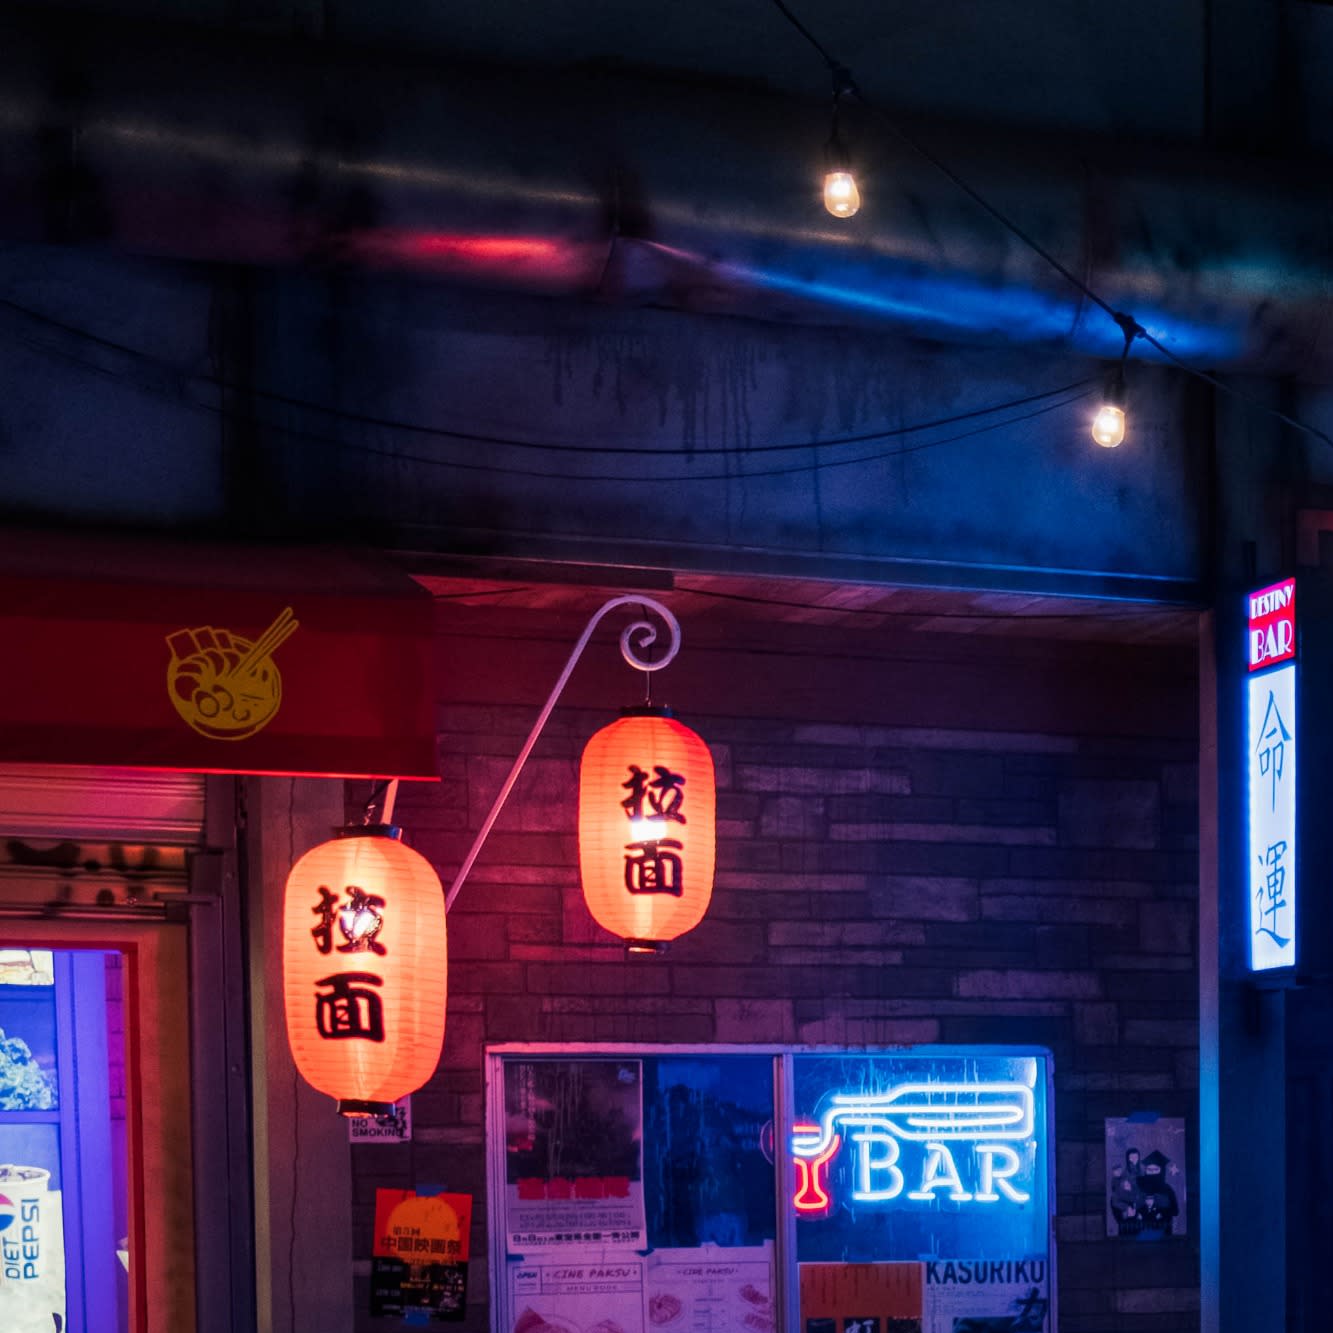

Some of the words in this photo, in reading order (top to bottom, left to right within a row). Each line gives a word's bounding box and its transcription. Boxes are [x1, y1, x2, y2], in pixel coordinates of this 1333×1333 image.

[1251, 583, 1295, 621] DESTINY
[1251, 614, 1293, 667] BAR
[620, 764, 687, 898] 拉面
[311, 885, 388, 1043] 拉面
[352, 1119, 368, 1129] NO
[852, 1133, 1029, 1203] BAR
[2, 1236, 21, 1280] DIET
[20, 1198, 40, 1280] PEPSI
[552, 1267, 582, 1280] CINE
